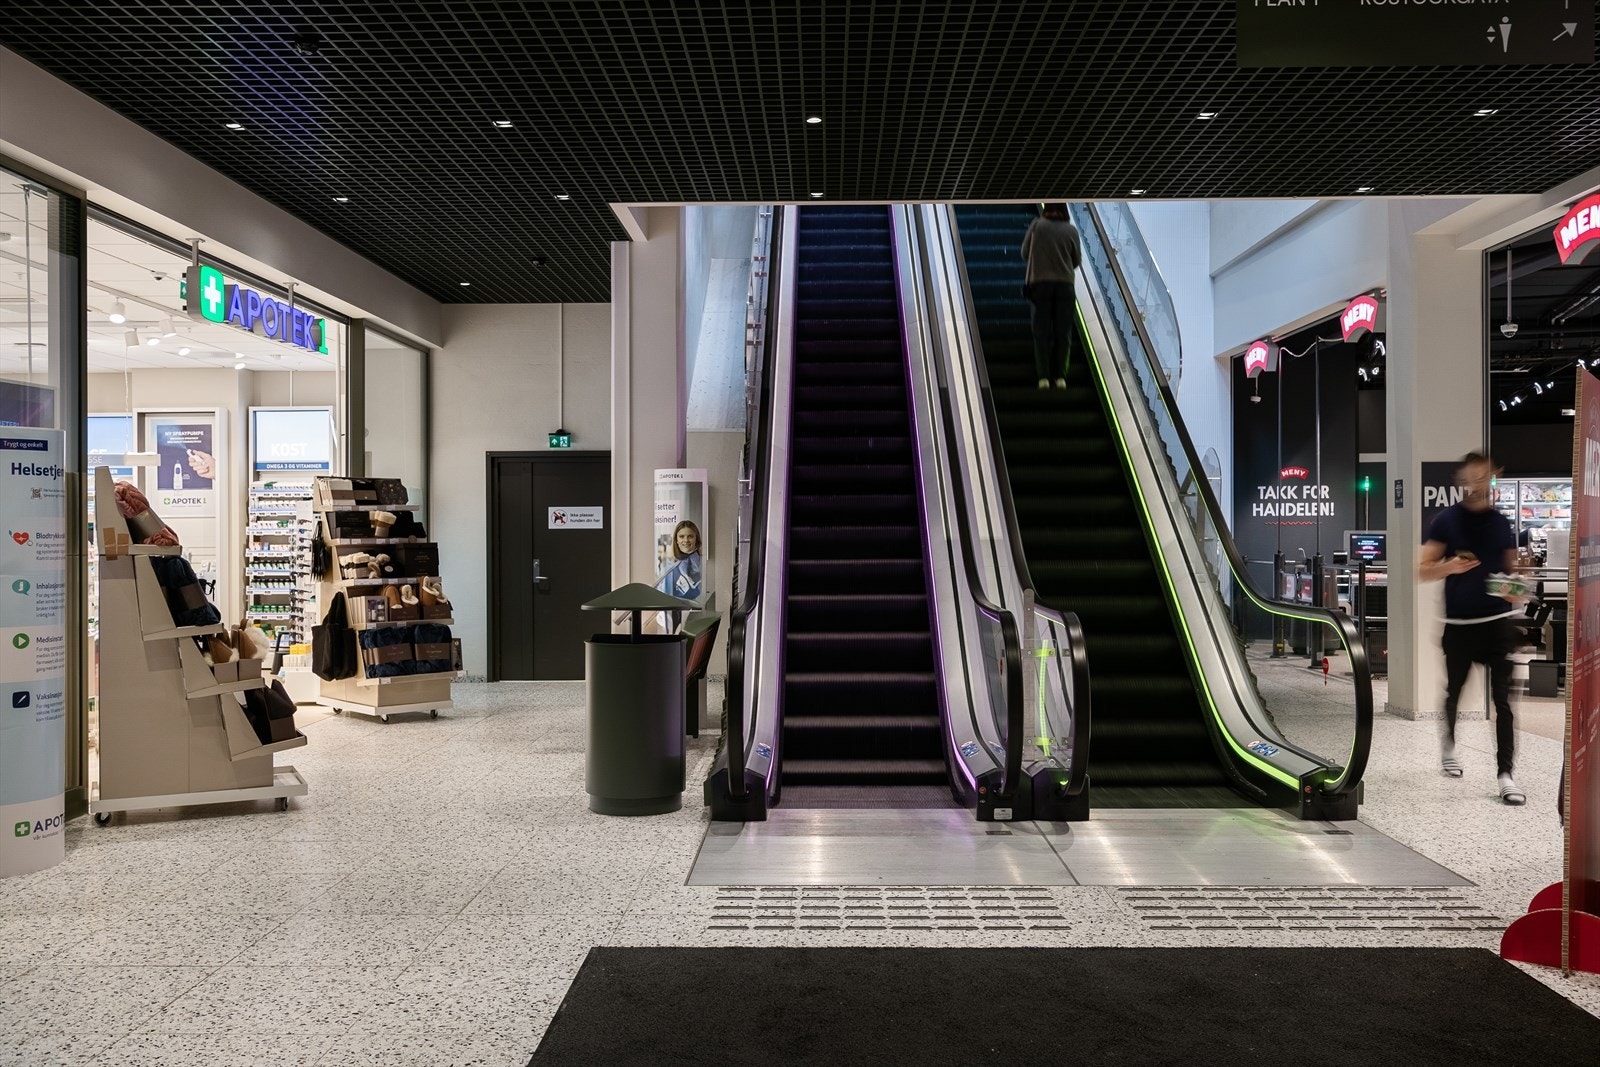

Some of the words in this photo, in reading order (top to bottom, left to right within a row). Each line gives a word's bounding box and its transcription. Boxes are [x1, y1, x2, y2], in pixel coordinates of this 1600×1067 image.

[228, 284, 316, 351] APOTEK
[319, 318, 328, 355] 1
[1344, 303, 1375, 332] MENY
[1246, 347, 1267, 369] MENY
[4, 441, 19, 449] Trygt
[271, 443, 308, 456] KOST
[1281, 469, 1306, 477] MENY
[1258, 485, 1298, 500] TAKK
[1303, 485, 1330, 499] FOR
[1252, 502, 1335, 517] HANDELEN!
